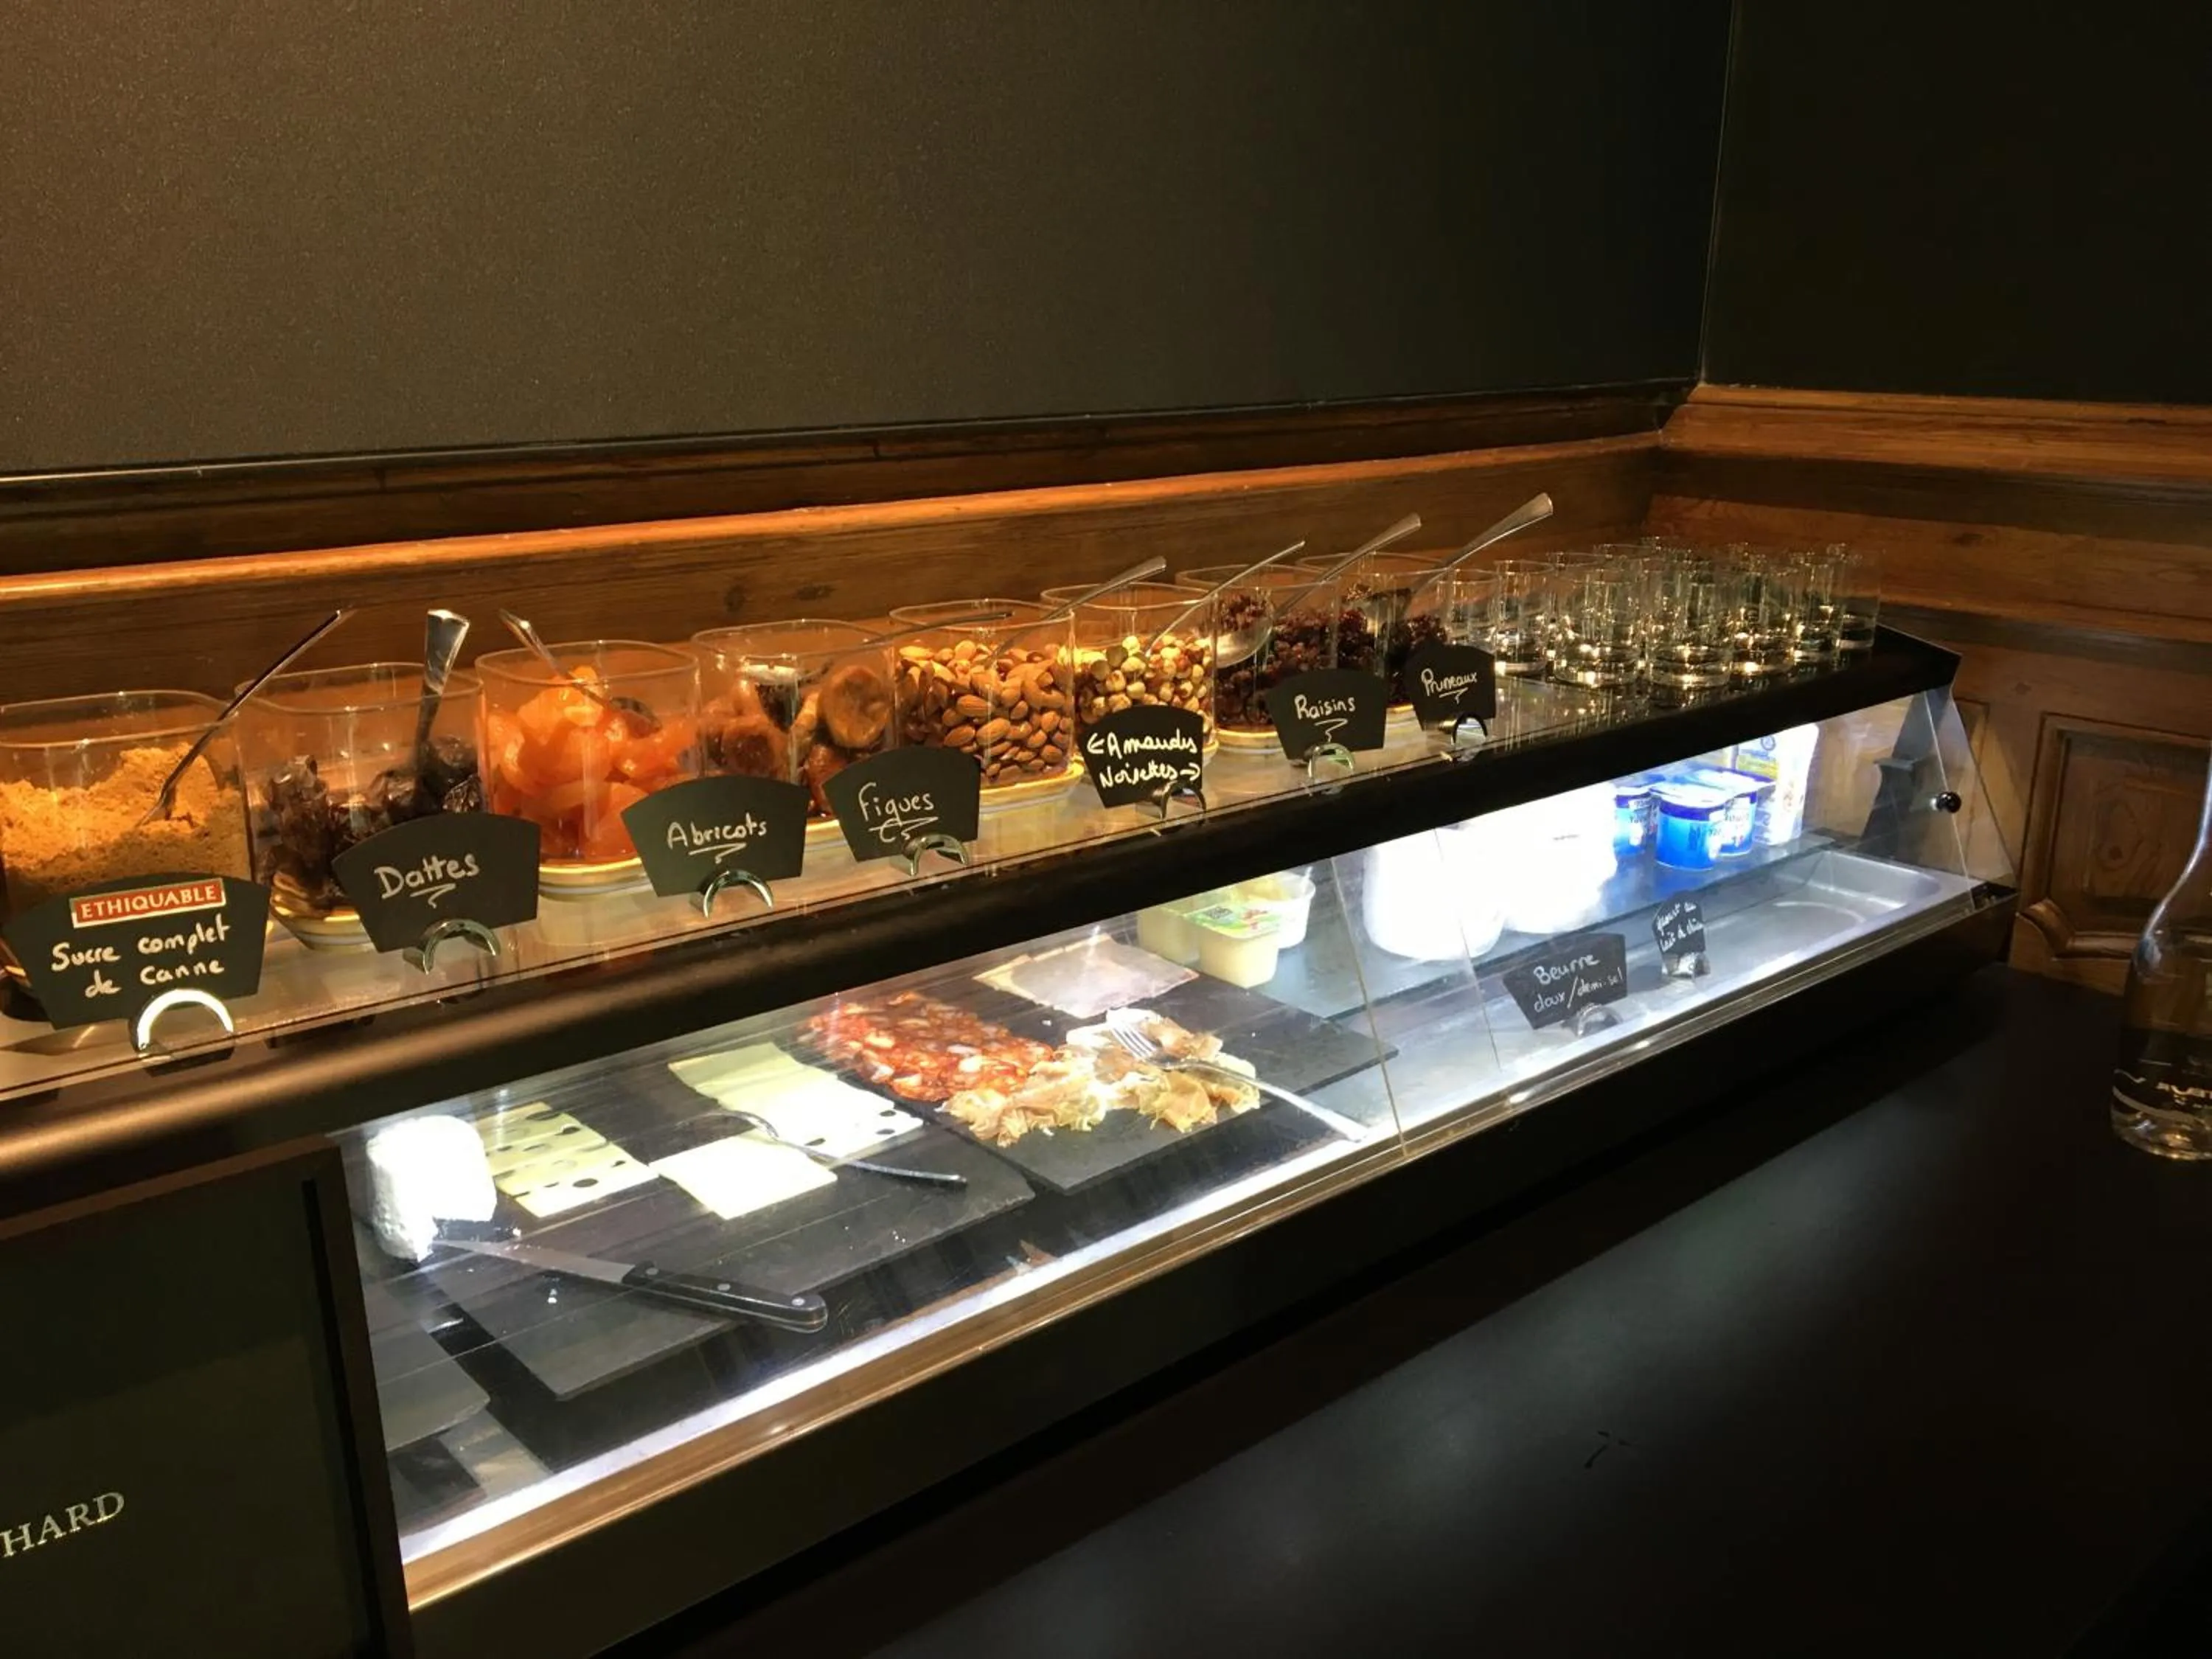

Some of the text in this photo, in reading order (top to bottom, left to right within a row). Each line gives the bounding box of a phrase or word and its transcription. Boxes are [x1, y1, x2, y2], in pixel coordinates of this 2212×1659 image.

[1421, 667, 1478, 697] Pruneaux
[1294, 694, 1356, 720] Raisins
[1099, 759, 1178, 789] Noisettes
[667, 812, 768, 849] Abricots
[858, 782, 935, 843] Figues
[374, 853, 480, 900] Dattes
[80, 884, 218, 920] ETHIQUABLE
[51, 912, 231, 972] Sucre complet
[84, 970, 122, 998] de
[1533, 953, 1601, 985] Beurre
[0, 1492, 125, 1558] HARD
